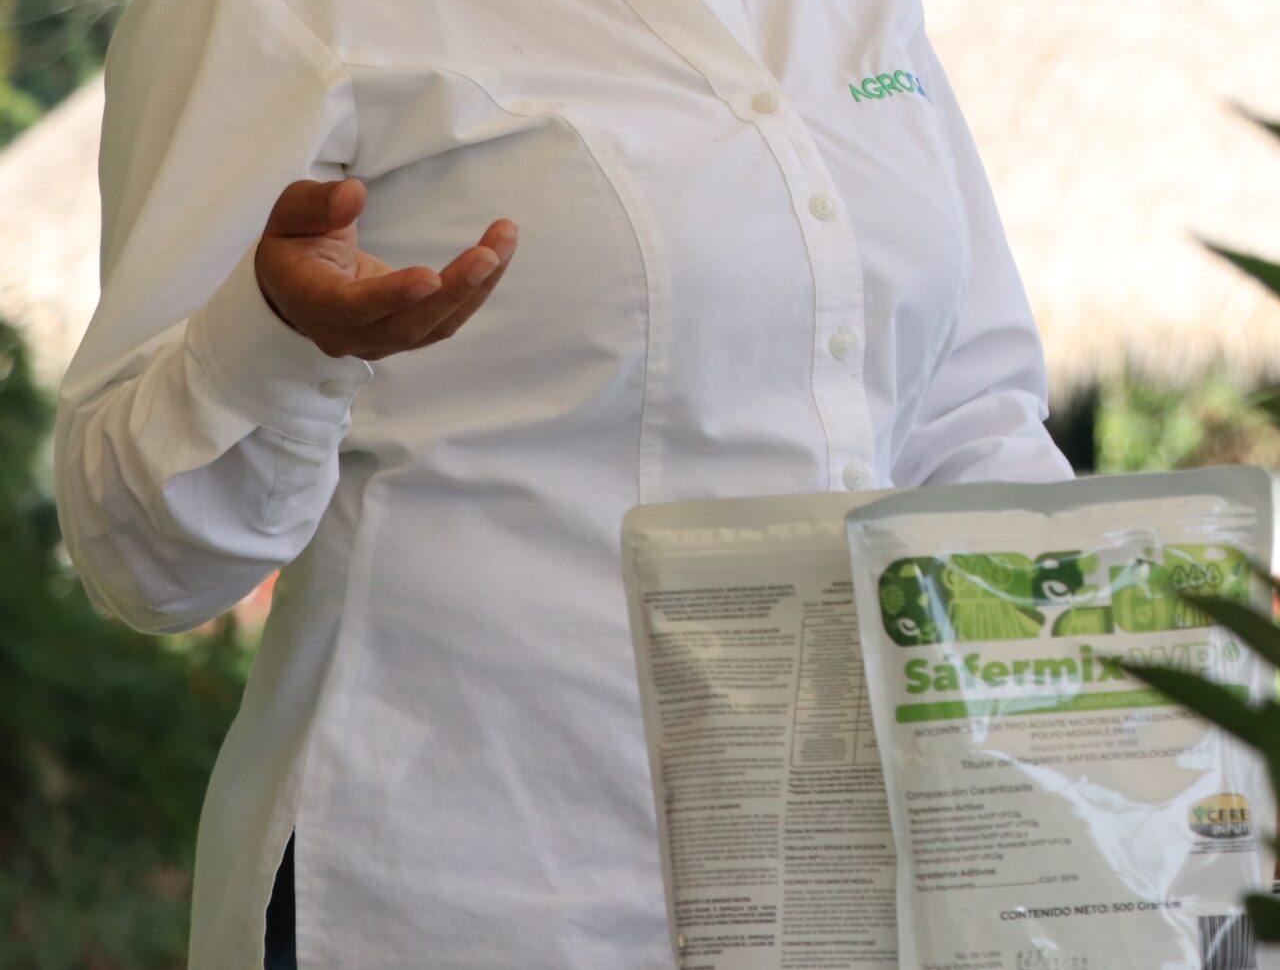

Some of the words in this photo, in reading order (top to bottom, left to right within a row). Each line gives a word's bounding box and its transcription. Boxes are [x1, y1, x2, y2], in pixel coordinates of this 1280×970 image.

[1207, 807, 1250, 822] CERE
[1000, 906, 1071, 921] CONTENIDO
[1075, 903, 1109, 916] NETO:
[1112, 901, 1135, 914] 500
